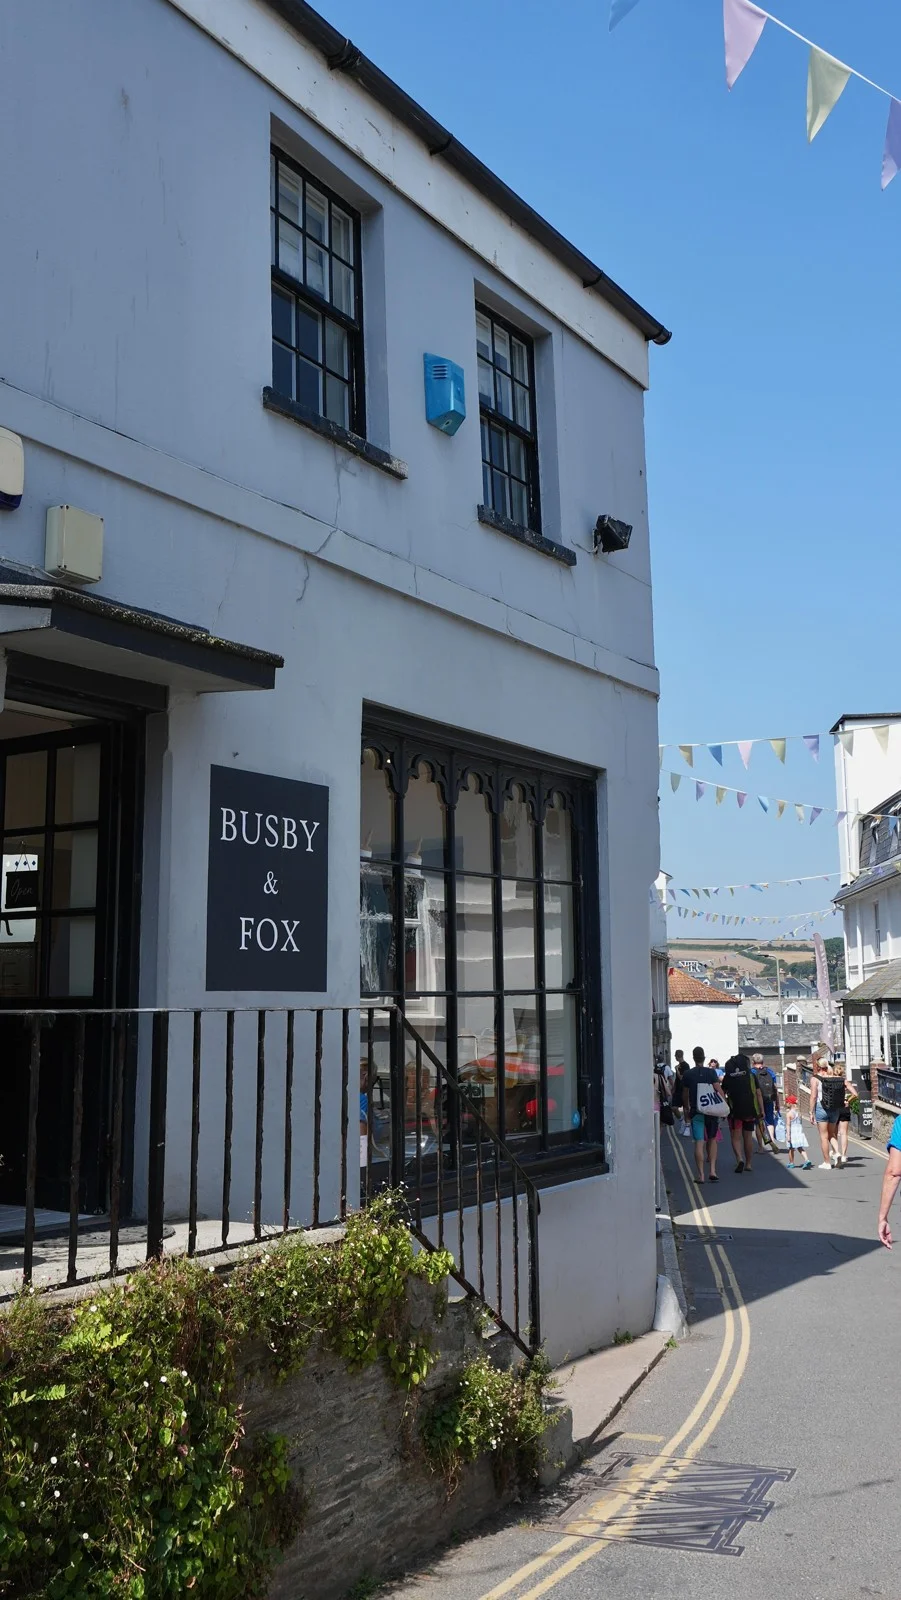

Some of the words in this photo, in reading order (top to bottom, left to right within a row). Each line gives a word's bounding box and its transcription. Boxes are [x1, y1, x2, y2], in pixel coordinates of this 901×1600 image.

[220, 807, 320, 852] BUSBY
[10, 878, 34, 903] Open
[263, 871, 279, 895] &
[239, 916, 300, 952] FOX
